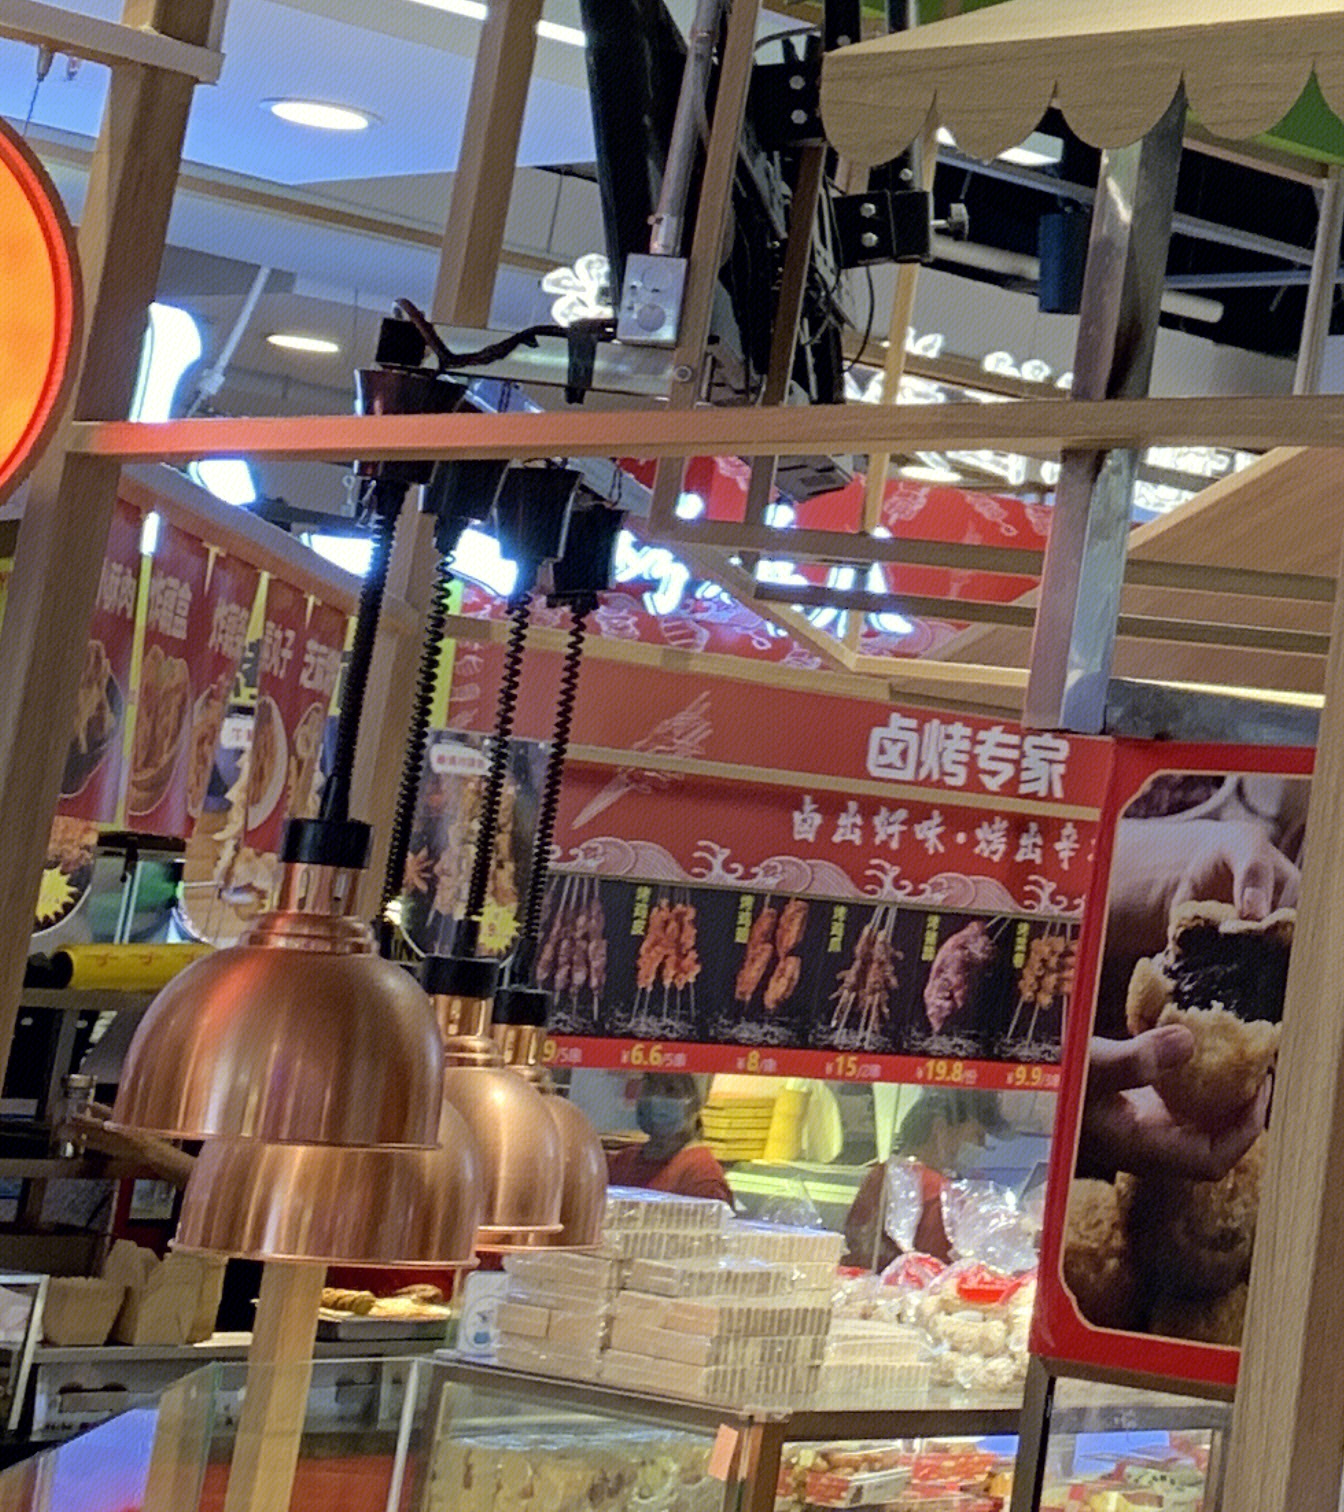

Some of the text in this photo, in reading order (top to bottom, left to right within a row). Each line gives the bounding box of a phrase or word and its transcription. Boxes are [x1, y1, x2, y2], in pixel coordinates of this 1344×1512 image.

[865, 711, 1071, 799] 卤烤专家
[792, 794, 1098, 871] 卤出好味·烤出辛
